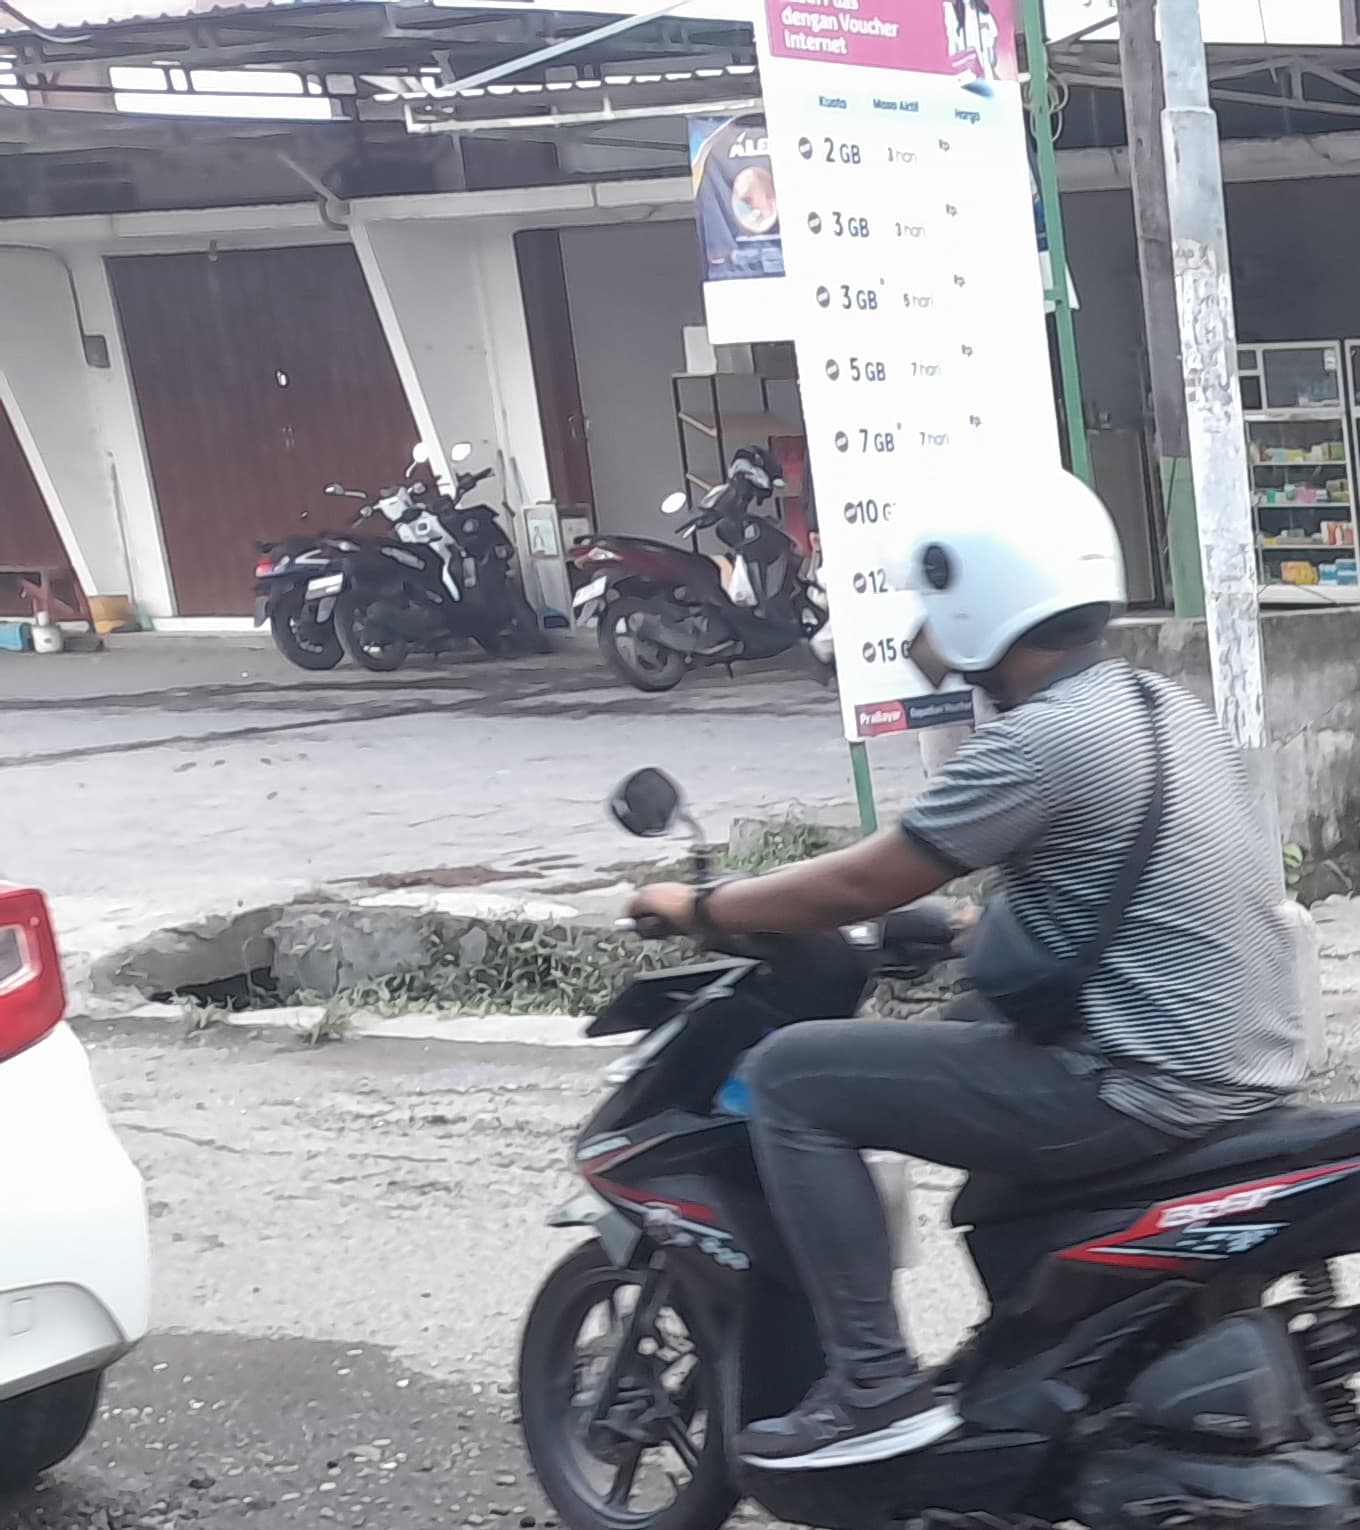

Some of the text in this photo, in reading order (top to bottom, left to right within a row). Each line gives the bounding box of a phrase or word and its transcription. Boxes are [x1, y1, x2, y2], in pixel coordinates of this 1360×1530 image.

[781, 7, 899, 38] dengan Voucher
[784, 29, 847, 54] Internet
[823, 137, 862, 165] 2 GB
[832, 211, 871, 238] 3 GB
[840, 284, 879, 311] 3 GB
[849, 356, 887, 382] 5 GB
[858, 428, 896, 454] 7 GB
[855, 498, 879, 524] 10
[868, 567, 889, 594] 12
[877, 637, 898, 664] 15
